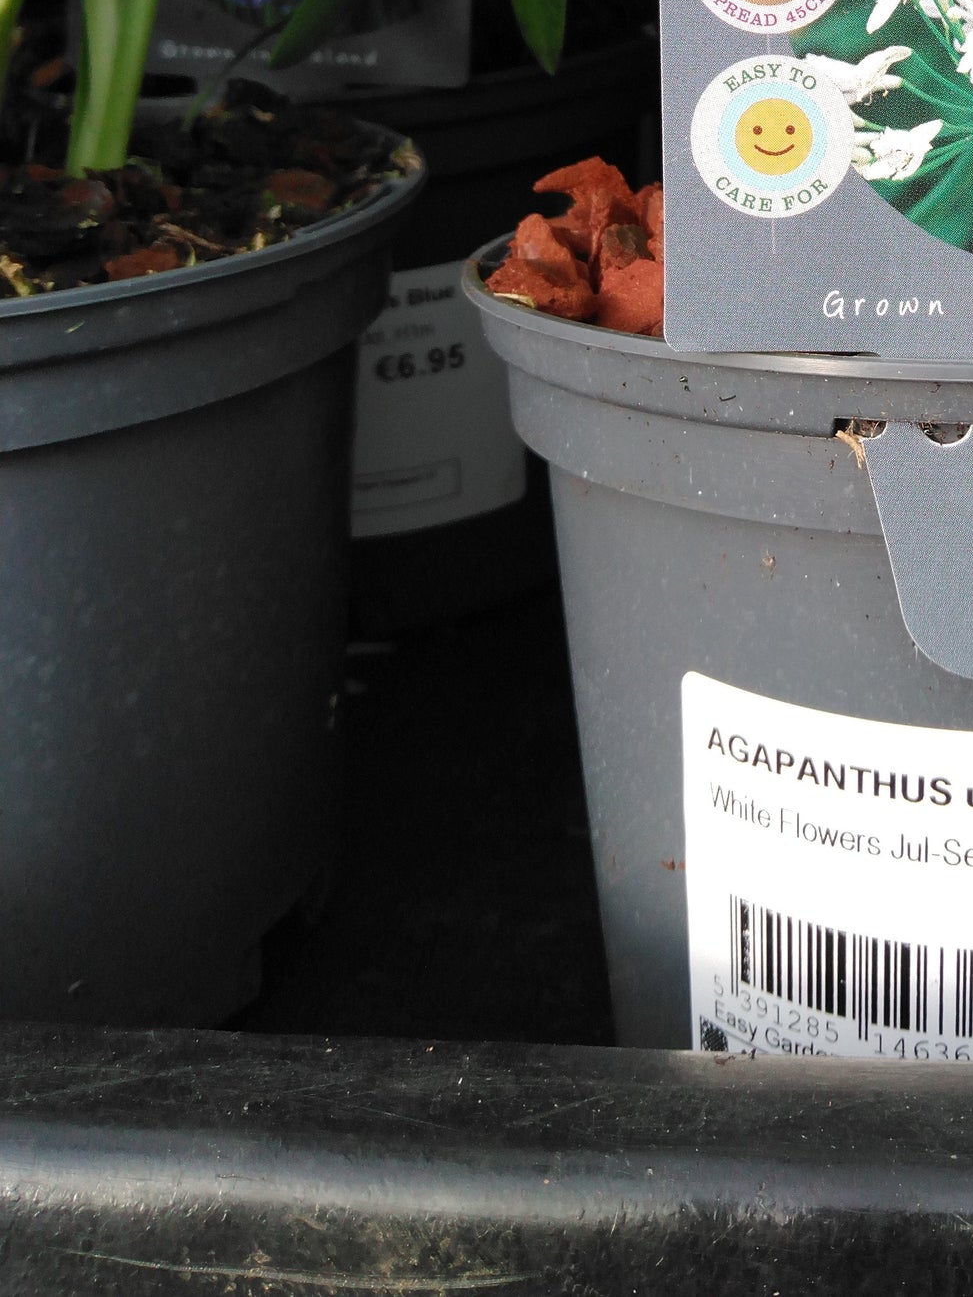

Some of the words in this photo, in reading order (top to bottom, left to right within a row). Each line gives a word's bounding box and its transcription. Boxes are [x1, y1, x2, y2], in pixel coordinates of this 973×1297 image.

[723, 63, 783, 94] EASY
[789, 67, 817, 91] TO
[715, 176, 773, 213] CARE
[782, 178, 829, 211] FOR
[822, 290, 945, 319] Grown
[708, 726, 953, 807] AGAPANTHUS
[710, 781, 772, 829] White
[780, 808, 882, 856] Flowers
[713, 974, 725, 996] 5
[739, 989, 839, 1043] 391285
[714, 999, 759, 1041] Easy
